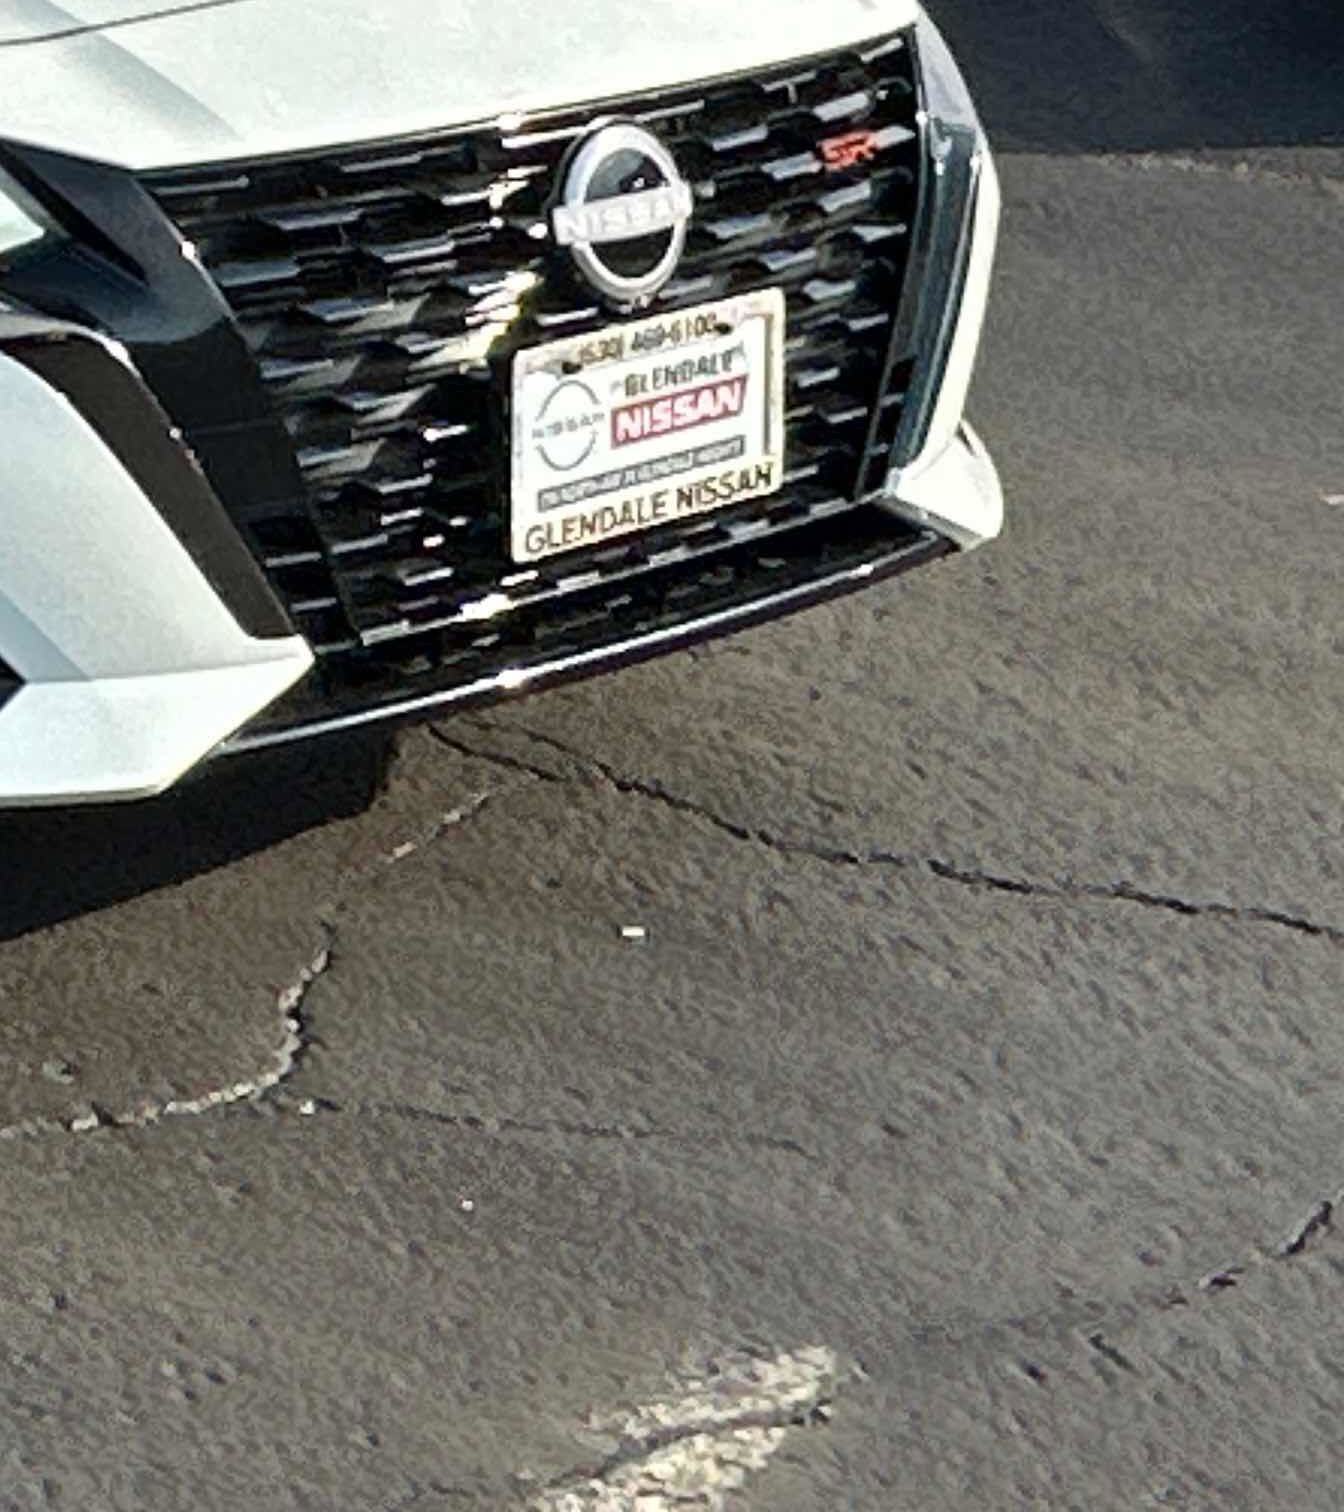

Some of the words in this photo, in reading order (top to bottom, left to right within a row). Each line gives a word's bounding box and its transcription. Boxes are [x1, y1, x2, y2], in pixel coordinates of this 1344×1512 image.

[625, 350, 734, 397] GLENDALE
[614, 380, 742, 442] NISSAN
[524, 490, 669, 554] GLENDALE
[675, 461, 775, 510] NISSAN
